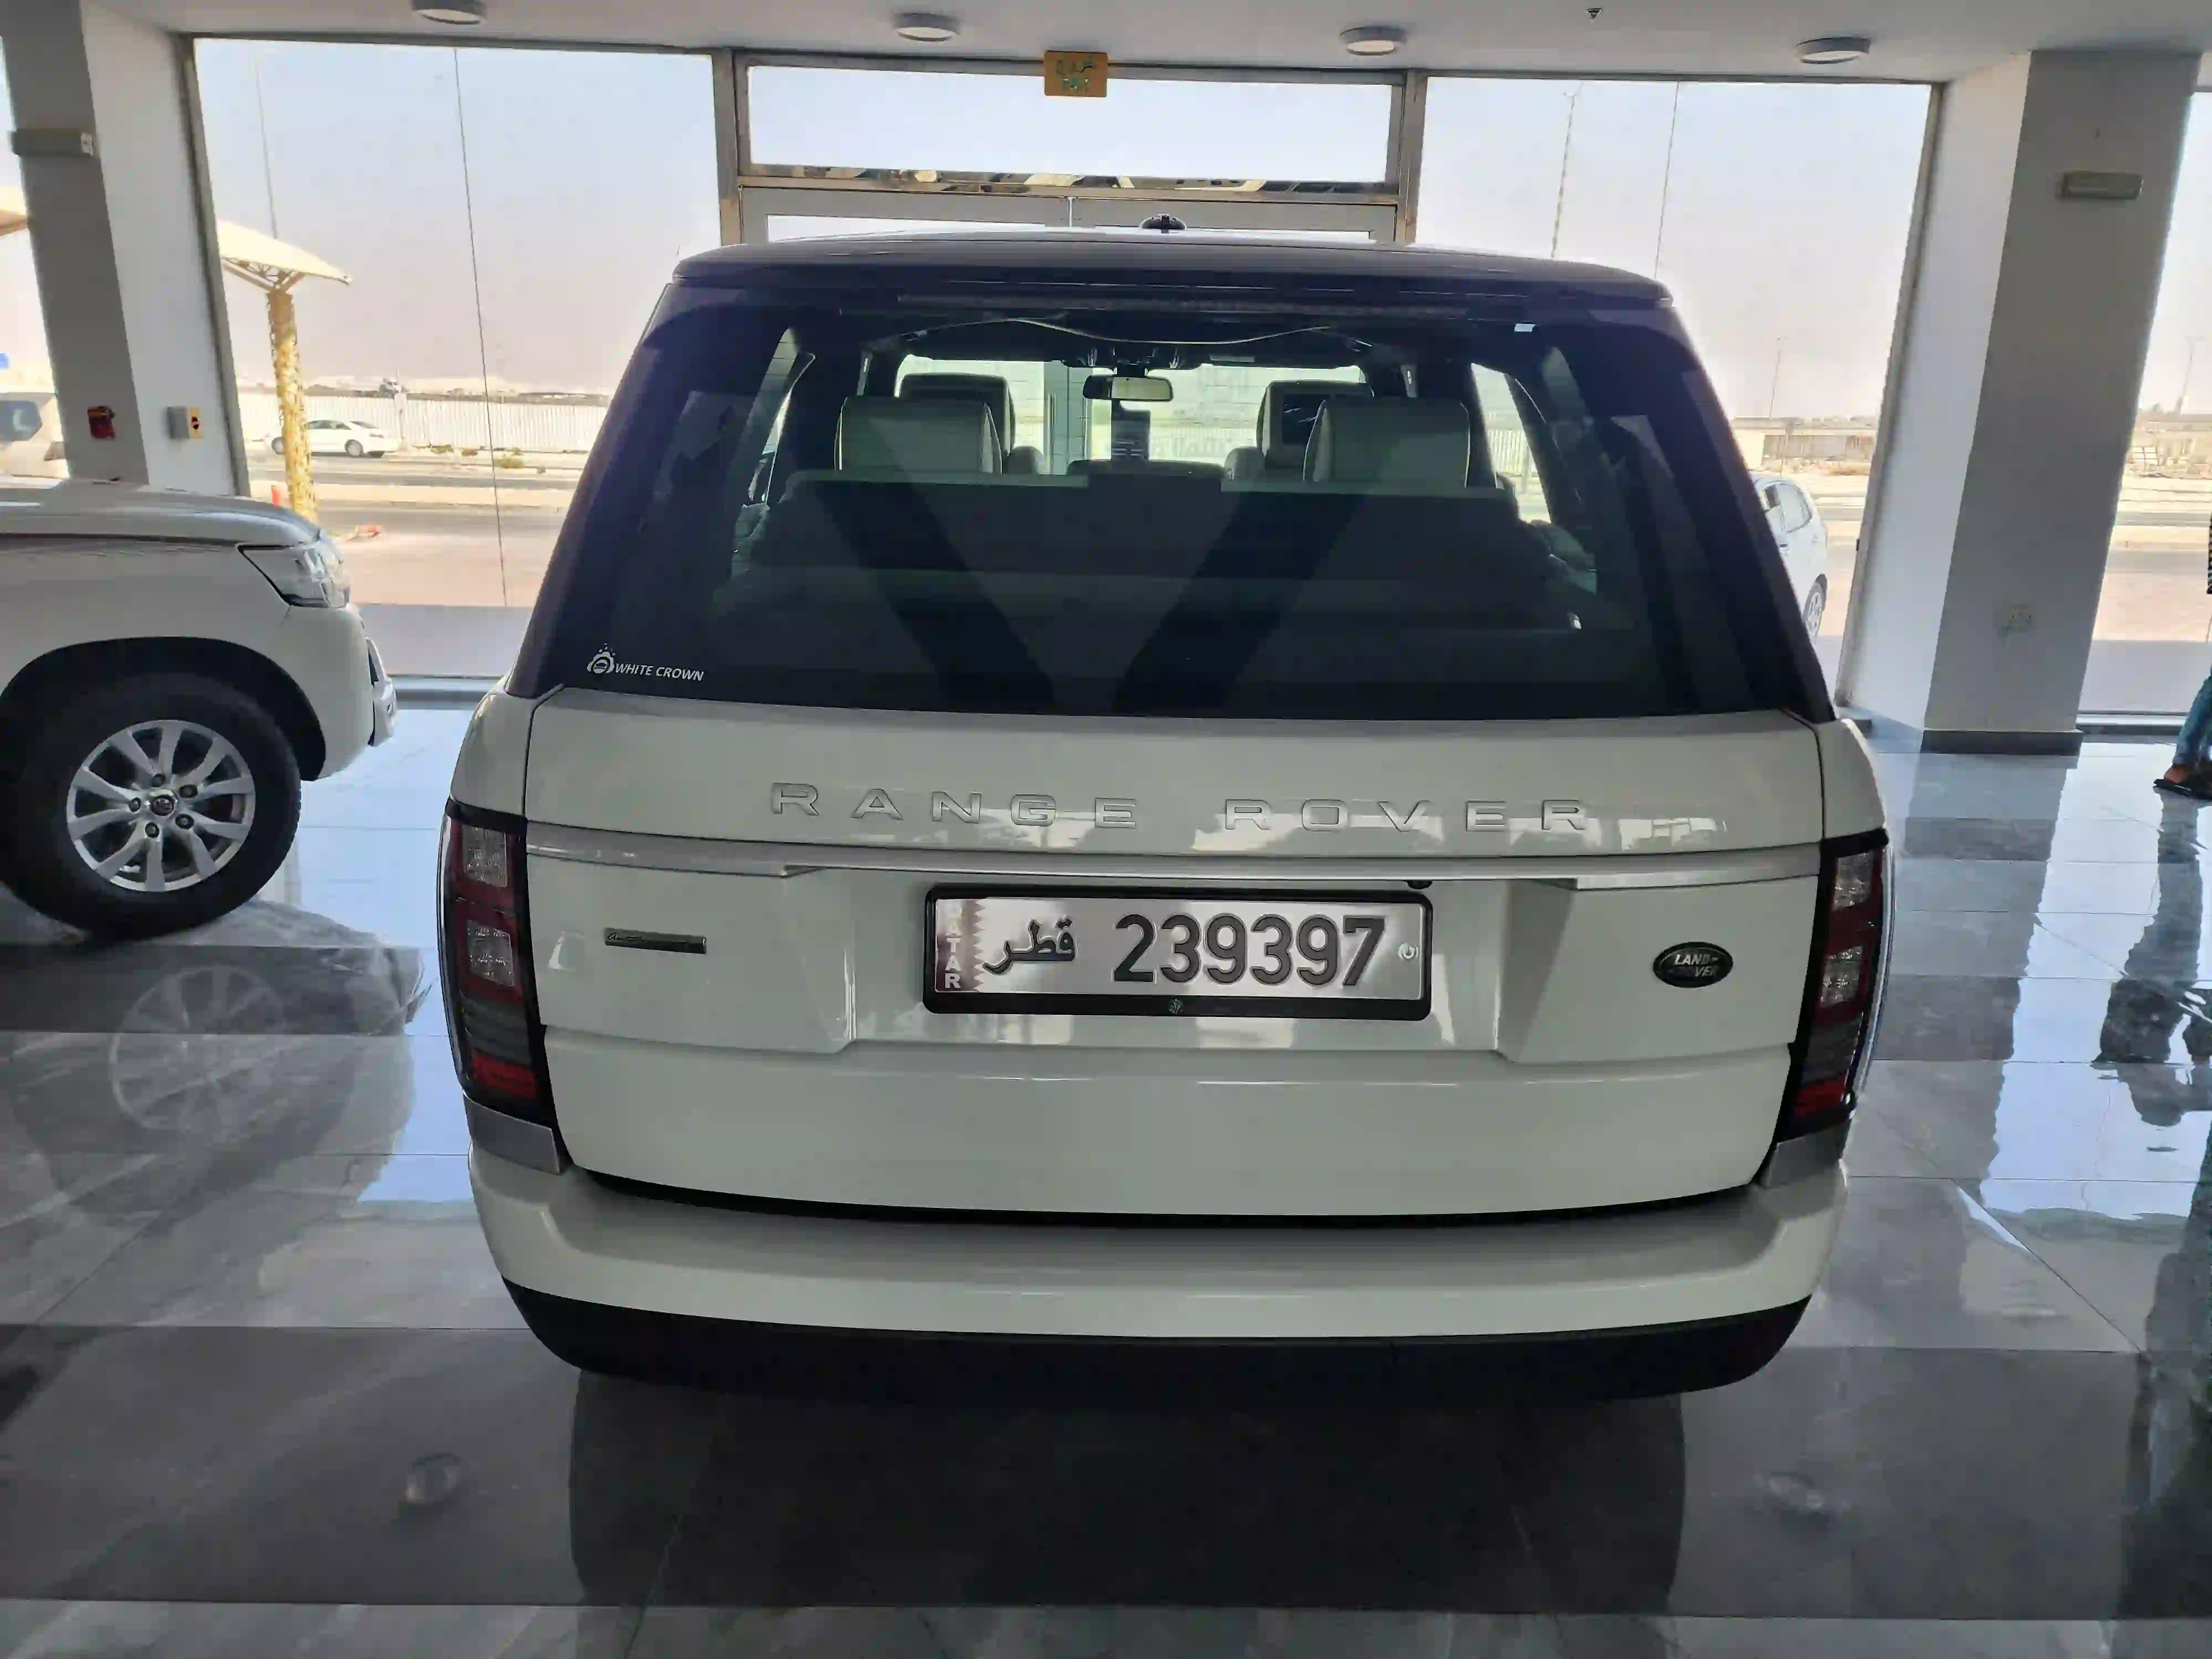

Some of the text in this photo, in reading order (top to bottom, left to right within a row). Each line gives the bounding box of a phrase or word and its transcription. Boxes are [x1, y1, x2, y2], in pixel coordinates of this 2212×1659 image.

[615, 663, 705, 682] WHITE CROWN
[772, 782, 1587, 833] RANGE ROVER
[982, 914, 1077, 975] قطر
[1112, 913, 1387, 988] 239397
[1673, 953, 1711, 965] LAND
